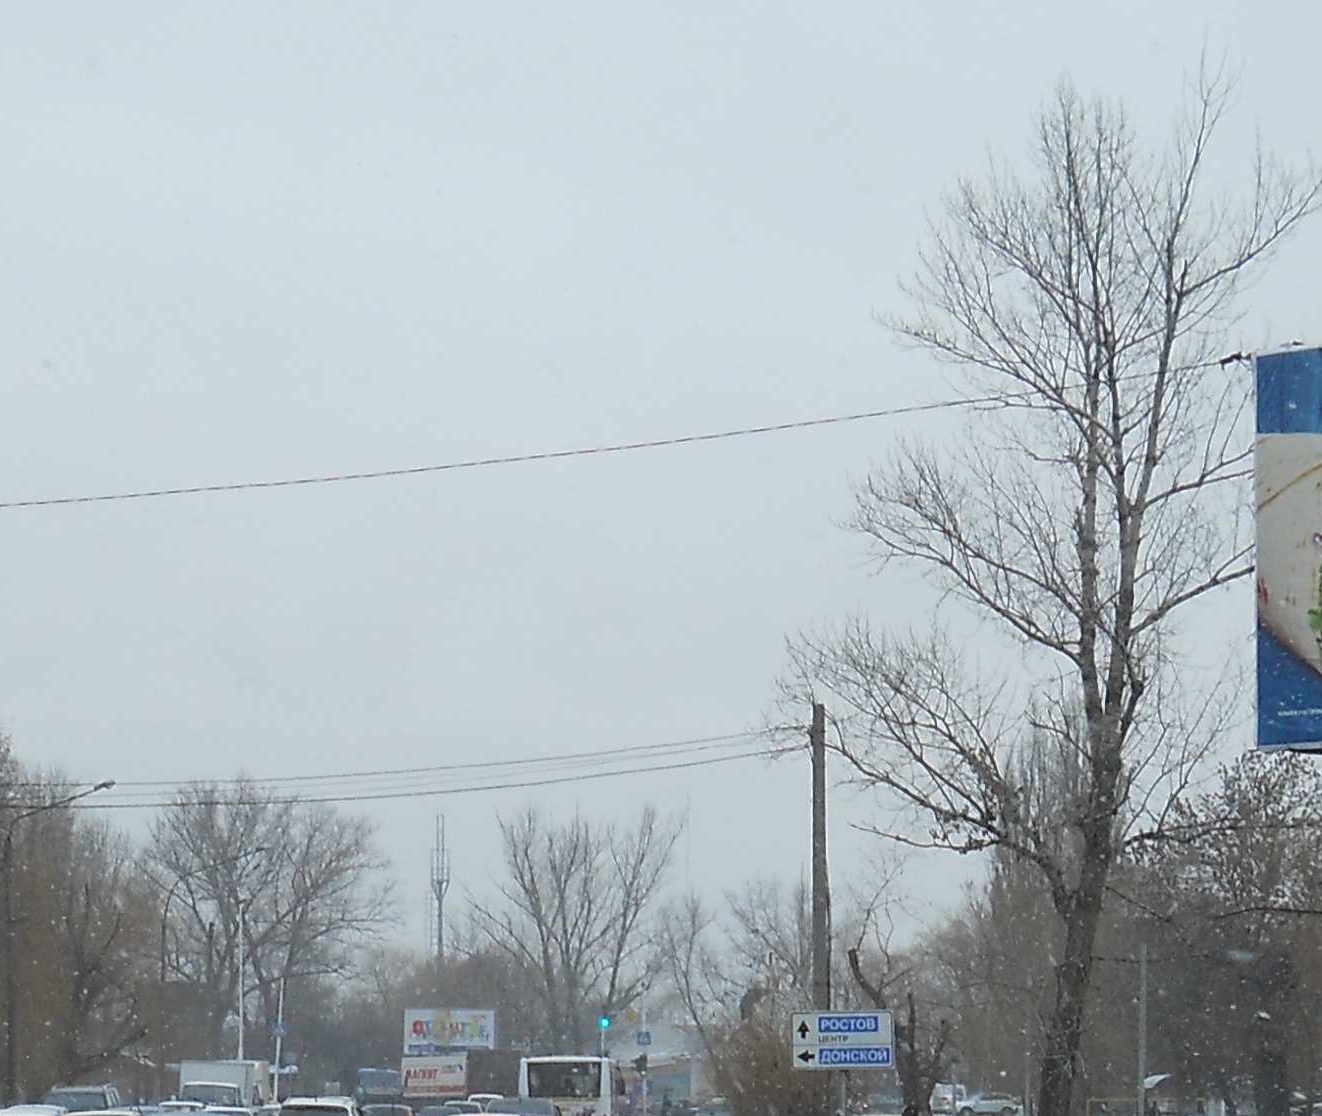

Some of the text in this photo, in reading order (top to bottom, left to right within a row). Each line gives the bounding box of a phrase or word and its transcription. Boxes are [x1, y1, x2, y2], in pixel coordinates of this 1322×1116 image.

[820, 1018, 876, 1031] РОСТОВ
[818, 1035, 849, 1043] ЦЕНТР
[821, 1048, 887, 1063] ДОНСКОЙ
